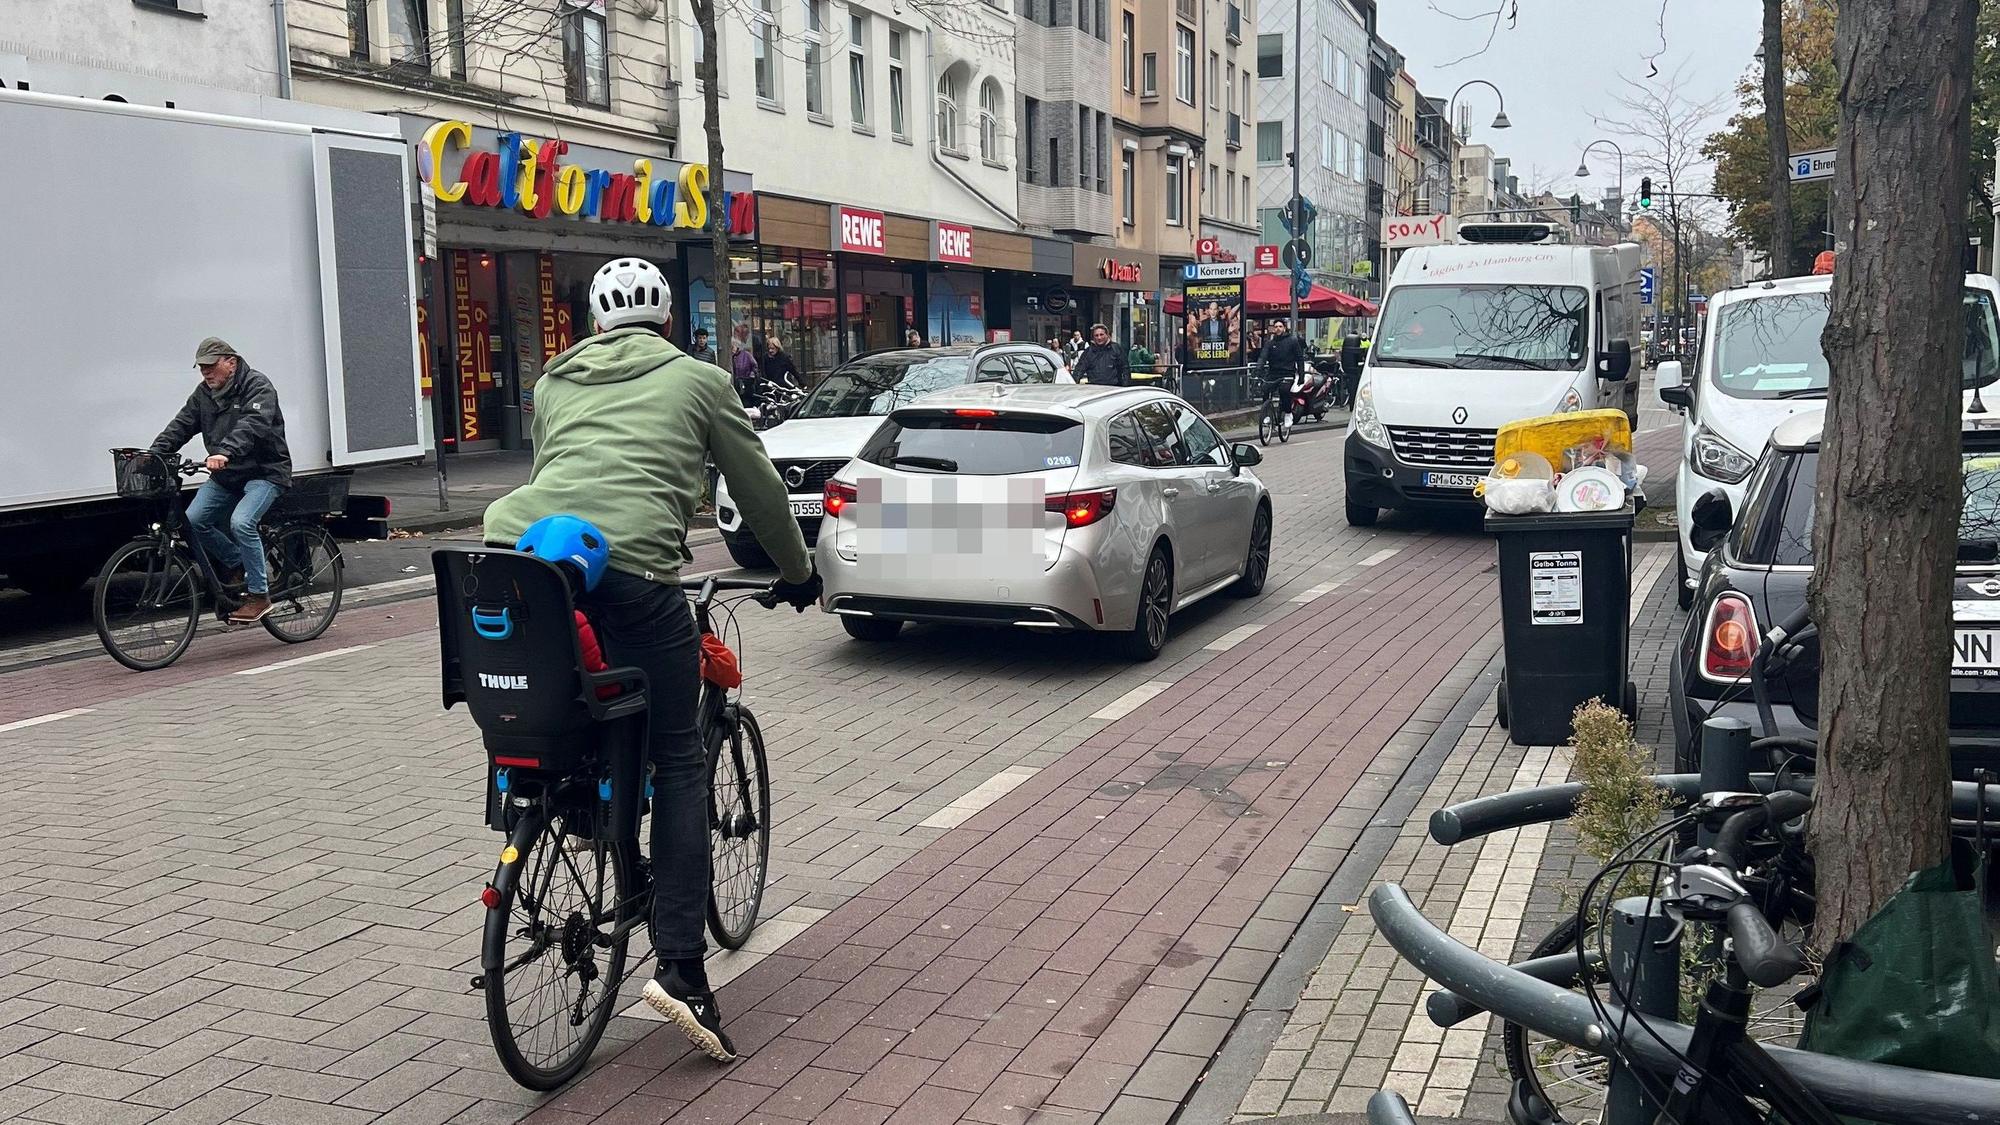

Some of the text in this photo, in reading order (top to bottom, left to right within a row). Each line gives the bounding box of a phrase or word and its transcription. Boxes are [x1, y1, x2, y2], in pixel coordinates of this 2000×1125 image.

[424, 120, 754, 235] CaliforniaSn
[842, 214, 883, 248] REWE
[1389, 214, 1444, 240] SONY
[939, 229, 971, 258] REWE
[1483, 255, 1532, 266] Hamburg
[1185, 265, 1196, 279] U
[455, 255, 478, 439] WELTNEUHEIT
[1201, 342, 1225, 350] EIN FEST
[1046, 456, 1072, 466] 0269
[1430, 473, 1444, 484] GM
[1450, 474, 1464, 486] CS
[790, 502, 822, 515] D 555
[1533, 560, 1555, 568] Gelbe
[478, 673, 529, 690] THULE
